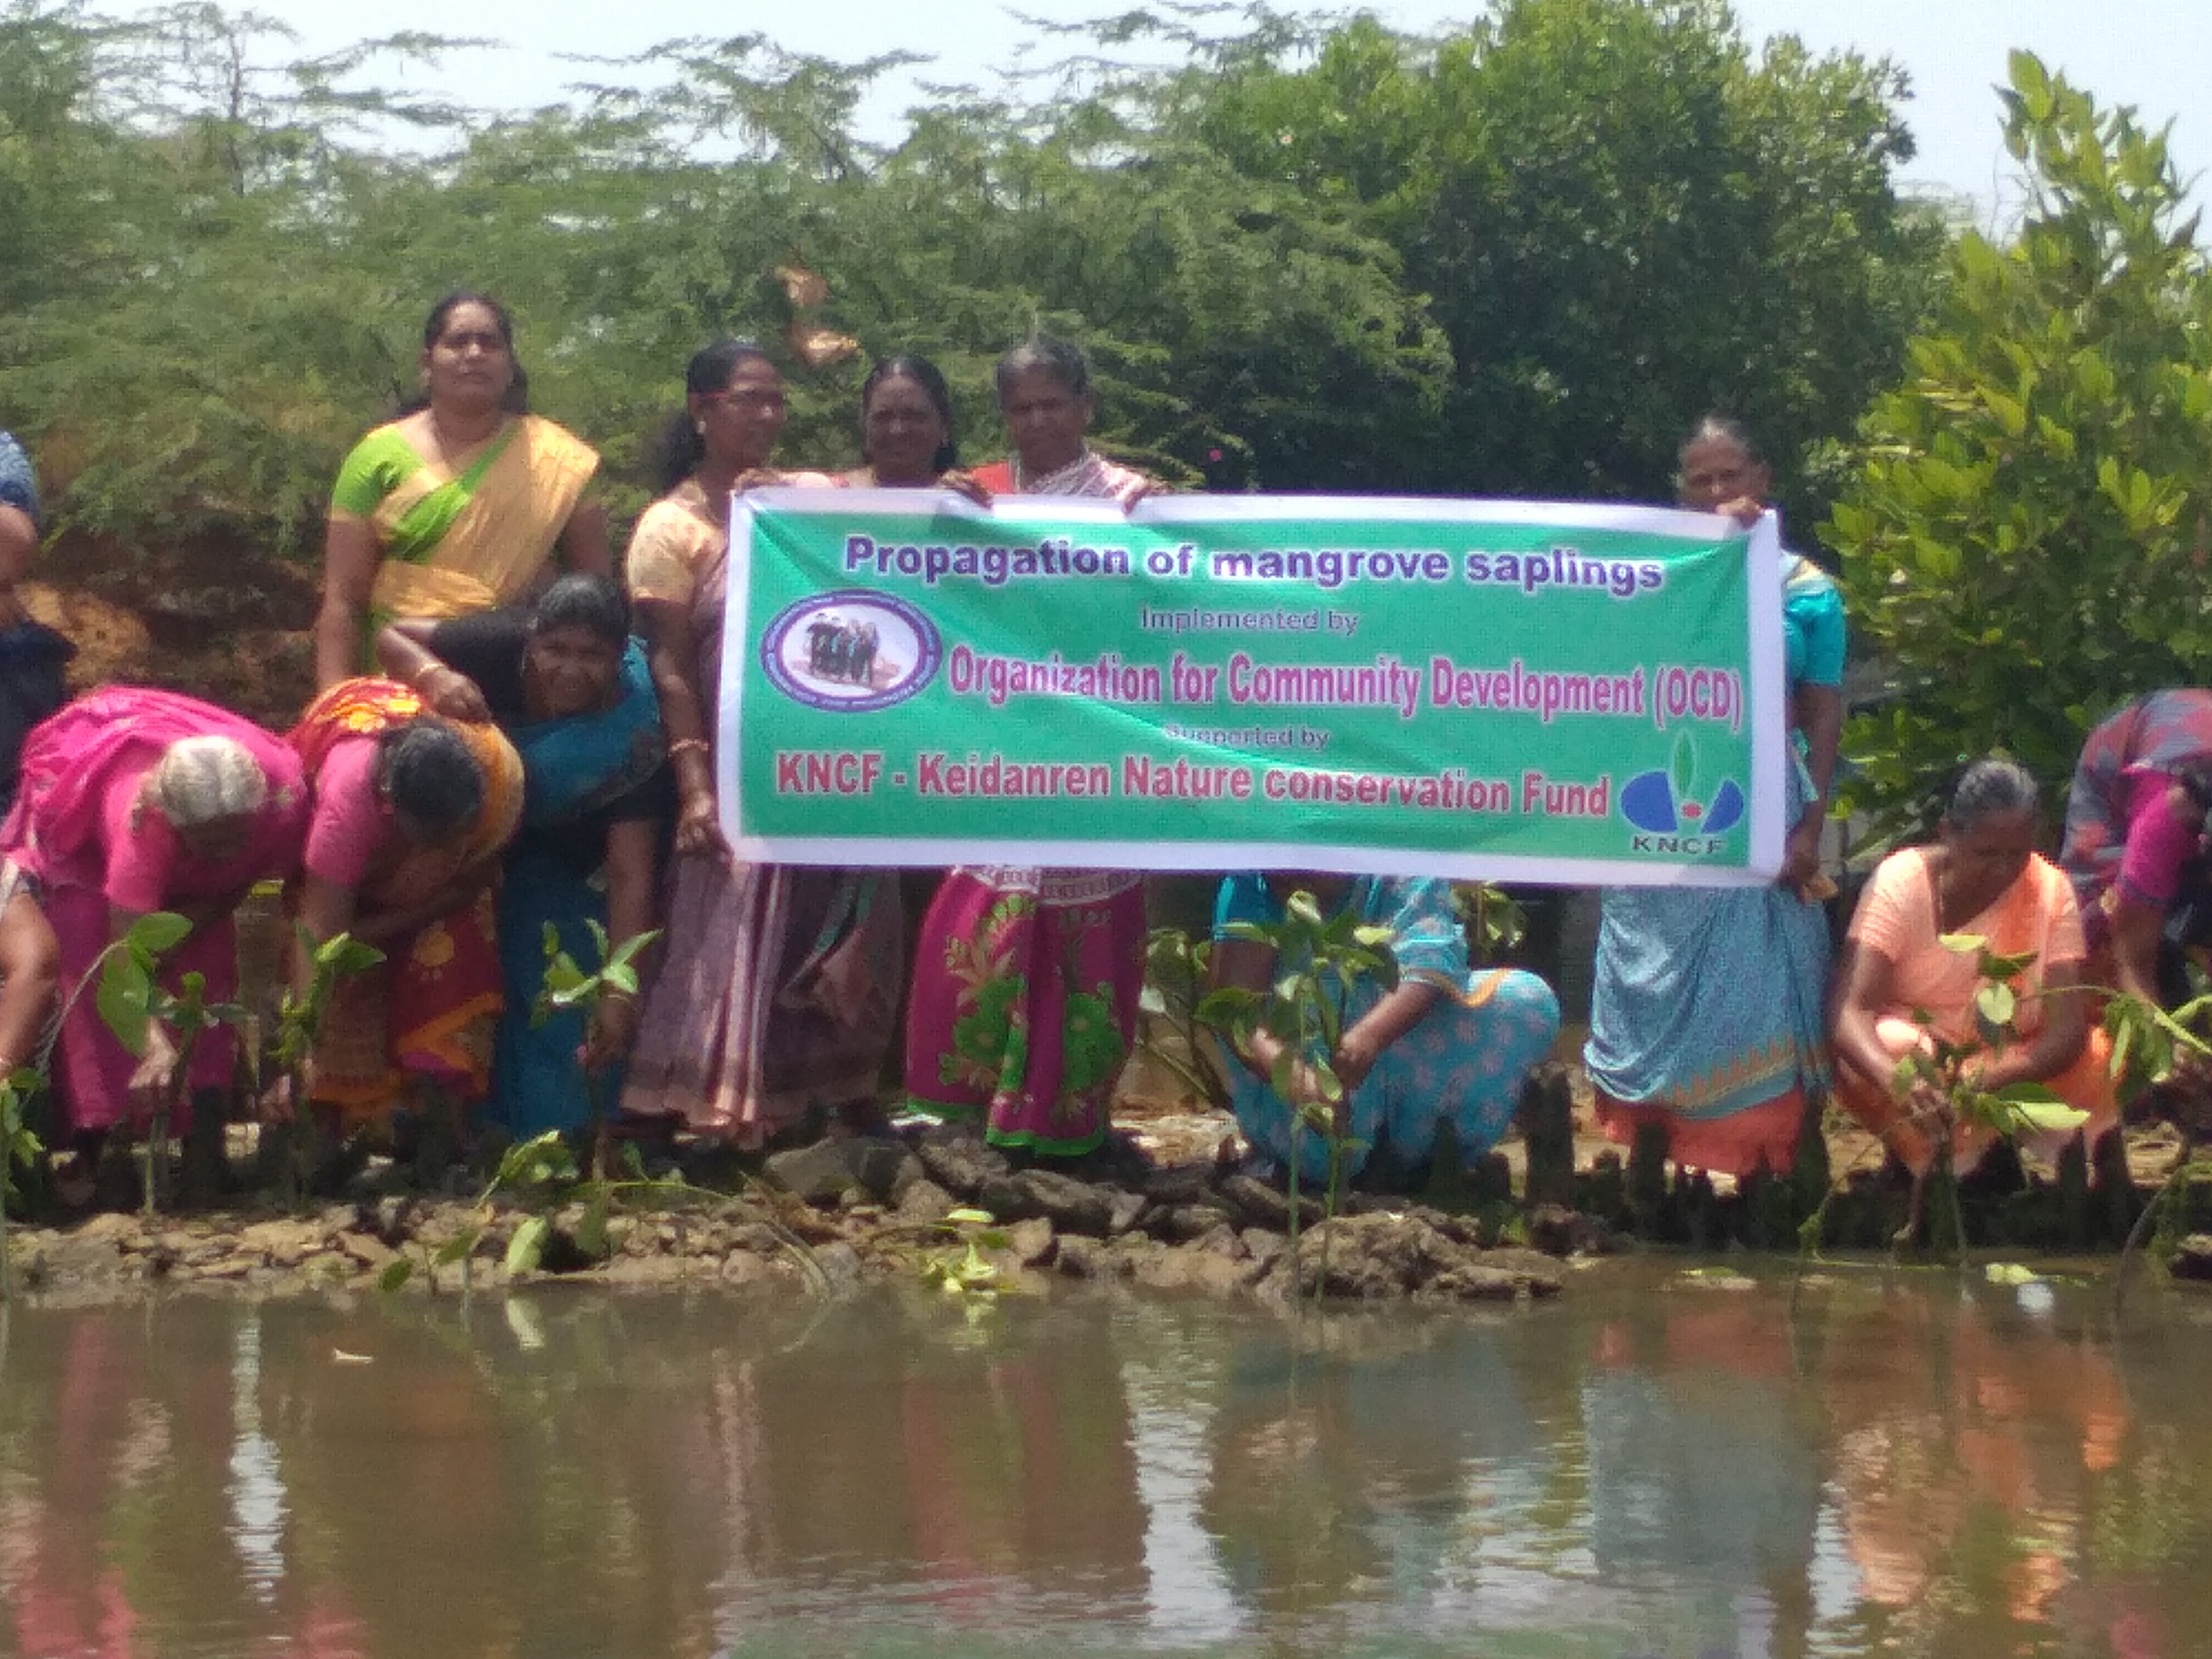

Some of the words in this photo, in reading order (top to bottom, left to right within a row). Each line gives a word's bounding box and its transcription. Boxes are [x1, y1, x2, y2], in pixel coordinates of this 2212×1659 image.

[845, 537, 1130, 583] Propagation
[1147, 544, 1195, 576] of
[1212, 549, 1450, 588] mangrove
[1467, 548, 1663, 596] saplings
[1142, 607, 1319, 633] Implemented
[1328, 609, 1358, 636] by
[950, 644, 1160, 705] Organization
[1171, 653, 1218, 703] for
[1228, 653, 1422, 719] Community
[1431, 657, 1644, 722] Development
[1656, 666, 1742, 733] (OCD)
[1301, 727, 1330, 750] by
[776, 752, 881, 796] KNCF
[918, 754, 1110, 798] Keidanren
[1123, 755, 1251, 800] Nature
[1264, 769, 1510, 812] conservation
[1523, 773, 1609, 816] Fund
[1633, 835, 1726, 855] KNCF
